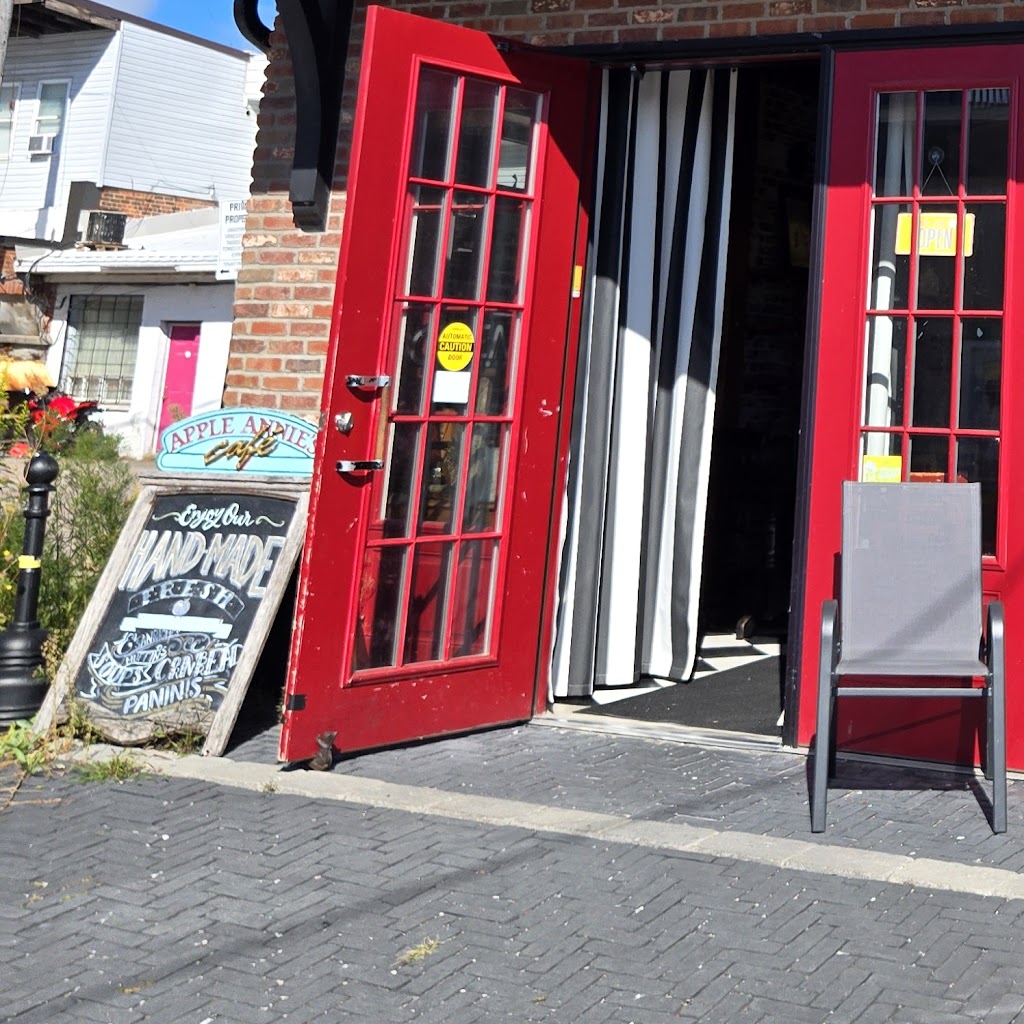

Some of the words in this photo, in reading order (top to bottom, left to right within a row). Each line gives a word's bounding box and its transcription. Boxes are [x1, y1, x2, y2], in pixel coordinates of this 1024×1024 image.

[920, 228, 952, 248] OPEN
[439, 342, 472, 352] CAUTION
[170, 416, 235, 453] APPLE
[179, 503, 224, 531] Enjoy
[222, 502, 255, 527] Our
[141, 580, 236, 610] FRESH
[92, 650, 144, 684] SOUPS
[122, 676, 203, 714] PANINIS
